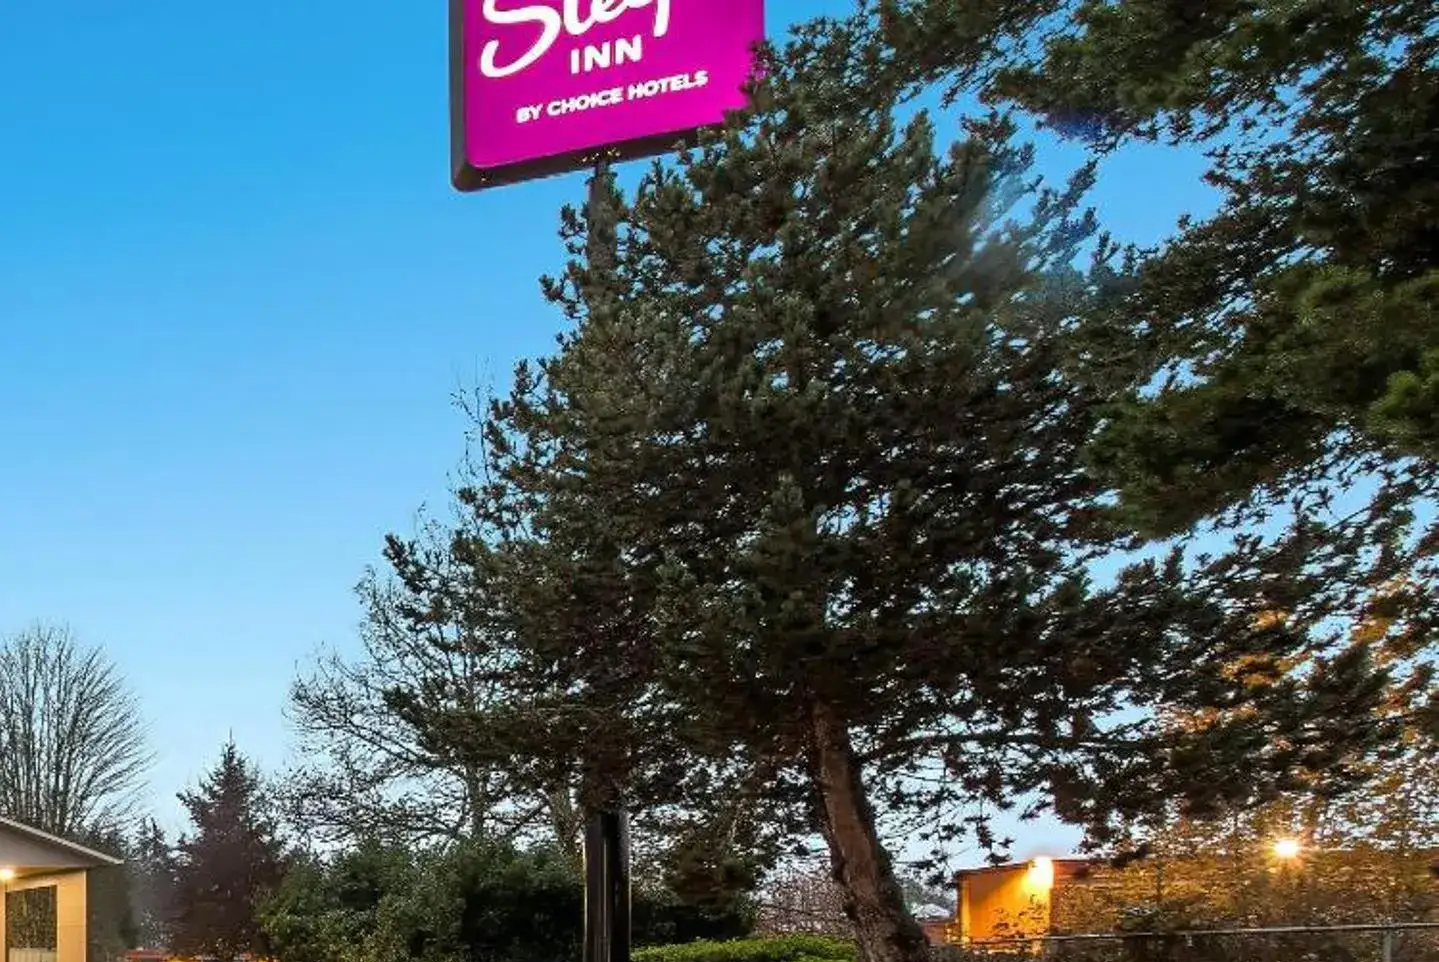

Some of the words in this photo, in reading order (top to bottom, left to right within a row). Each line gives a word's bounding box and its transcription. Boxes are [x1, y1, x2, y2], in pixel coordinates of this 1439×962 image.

[570, 34, 643, 75] INN
[516, 104, 542, 124] BY
[547, 87, 625, 117] CHOICE
[628, 70, 709, 101] HOTELS
